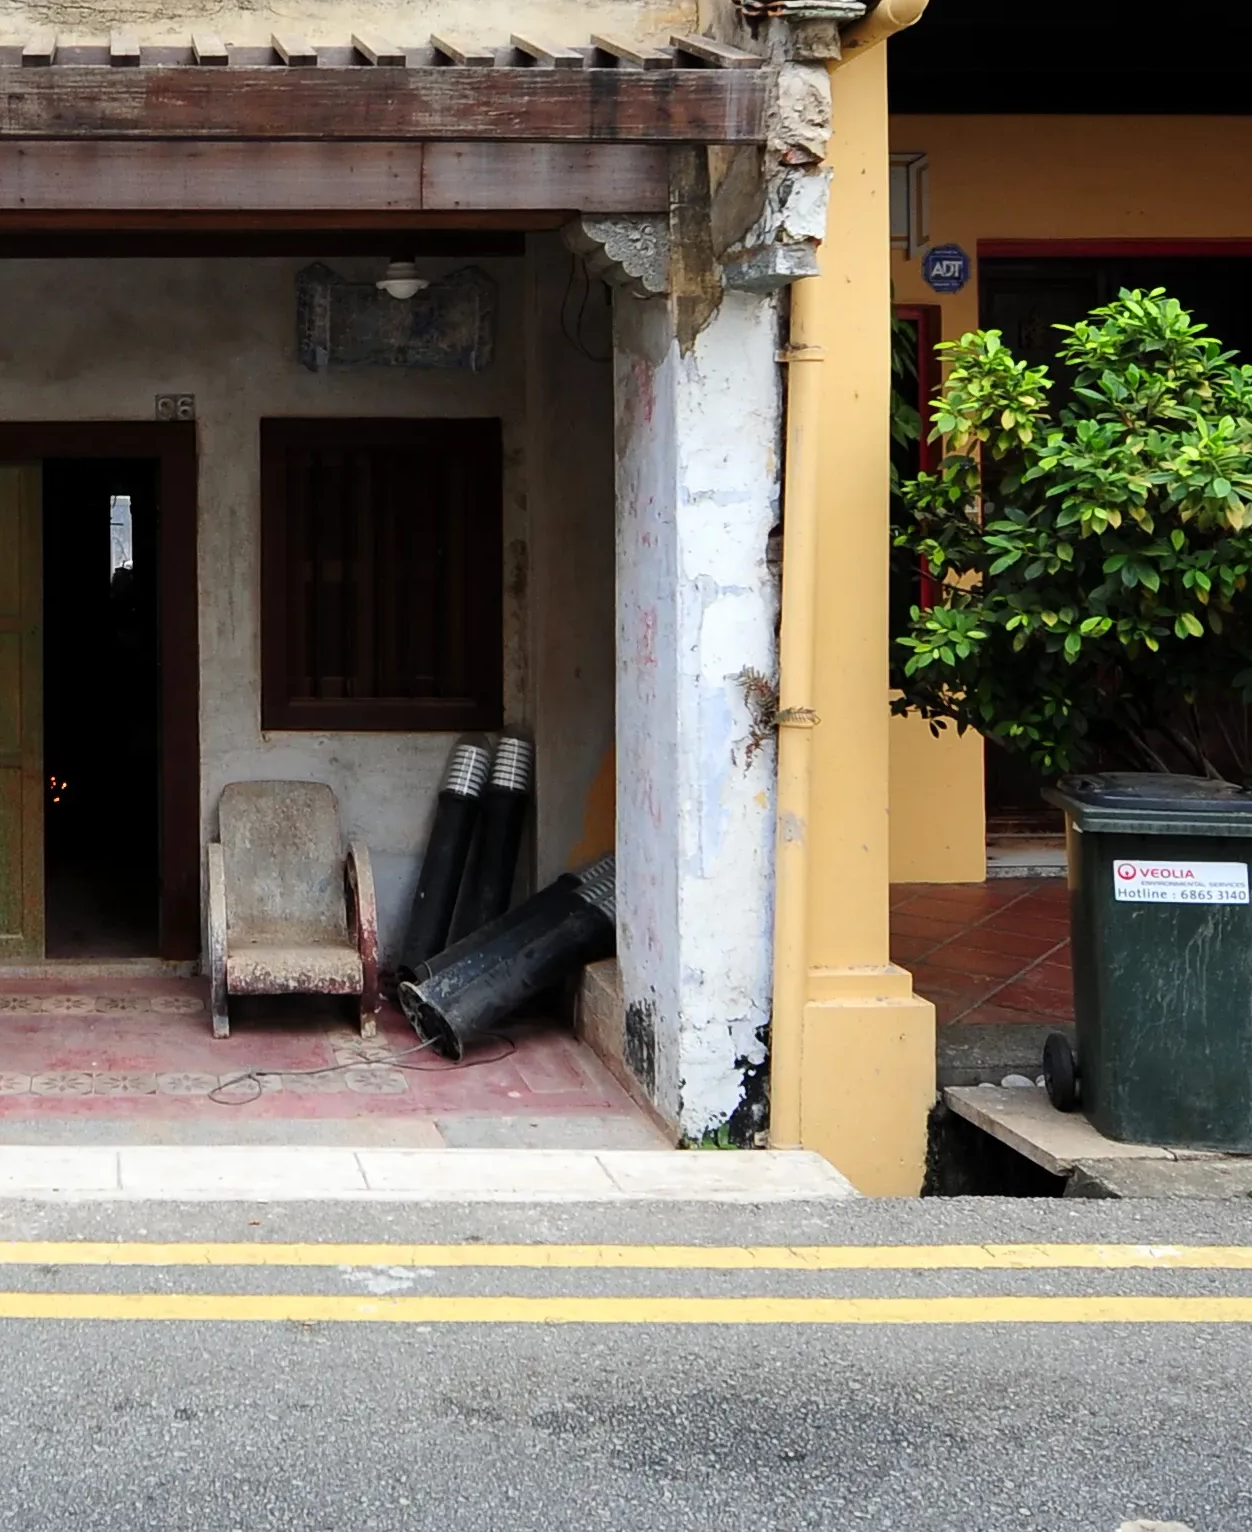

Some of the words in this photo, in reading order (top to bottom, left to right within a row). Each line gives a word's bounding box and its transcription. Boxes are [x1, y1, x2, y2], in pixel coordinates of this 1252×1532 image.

[931, 260, 963, 278] ADT
[1139, 868, 1195, 879] VEOLIA
[1118, 888, 1168, 899] Hotline
[1180, 889, 1213, 900] 6865
[1217, 890, 1247, 901] 3140
